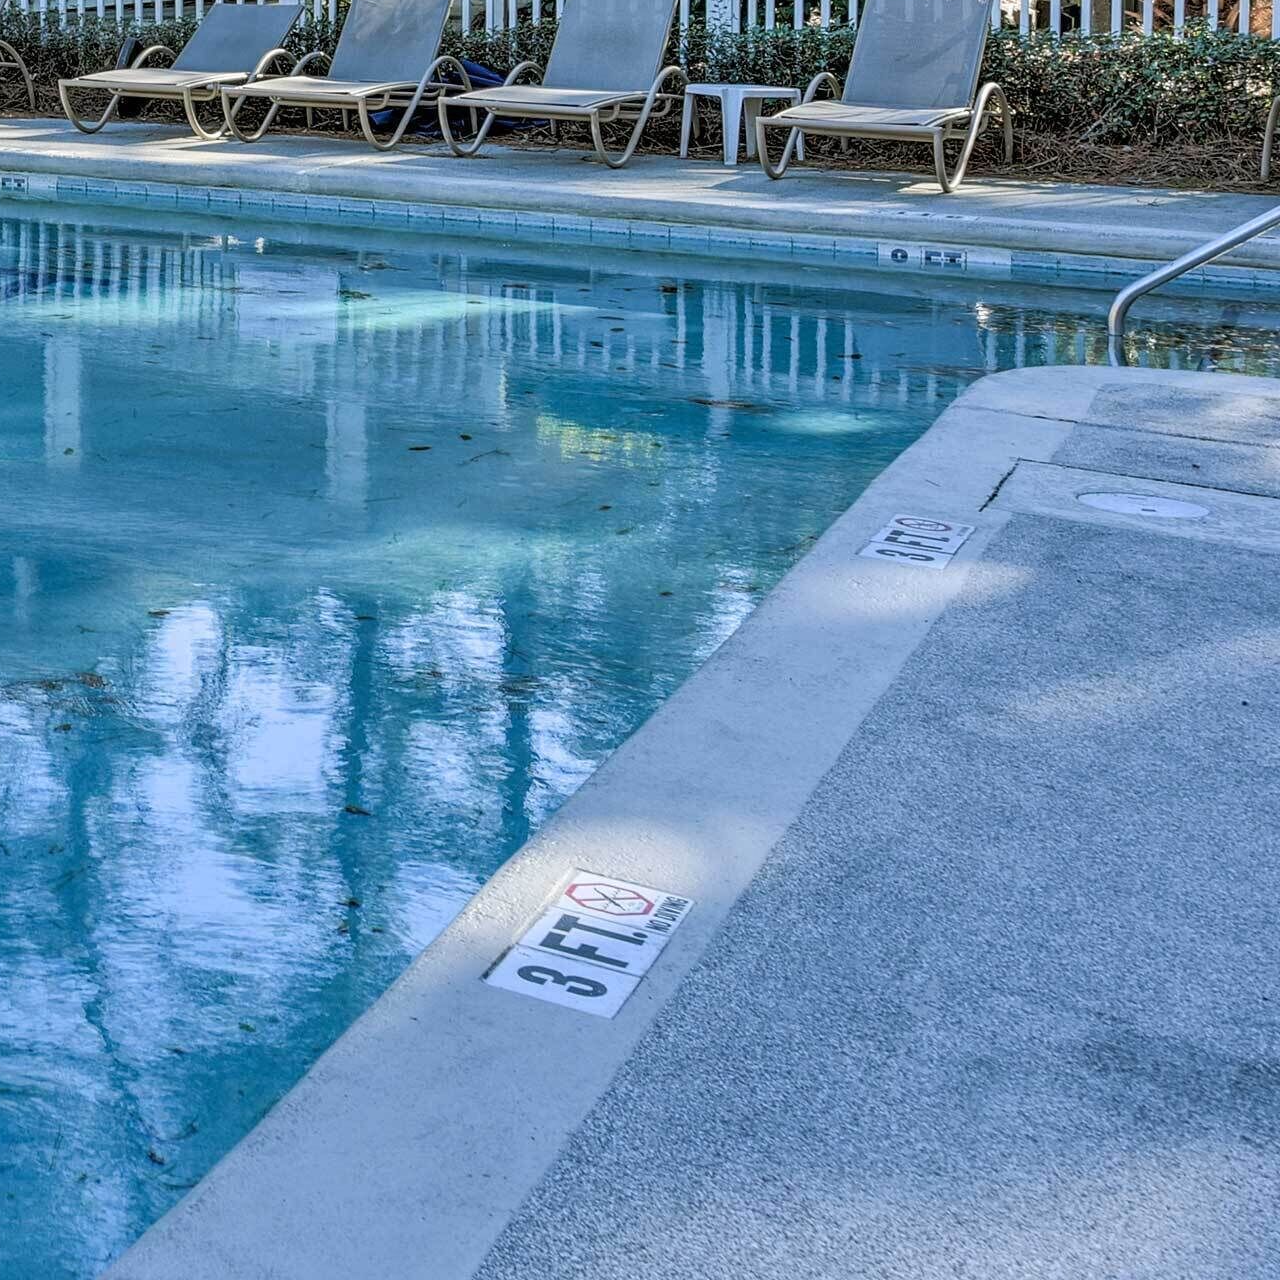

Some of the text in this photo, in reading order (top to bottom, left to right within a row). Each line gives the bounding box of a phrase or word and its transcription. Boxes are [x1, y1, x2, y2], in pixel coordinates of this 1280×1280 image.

[875, 549, 935, 561] 3
[644, 896, 689, 933] NO DIVING
[517, 914, 648, 997] 3 FT.
